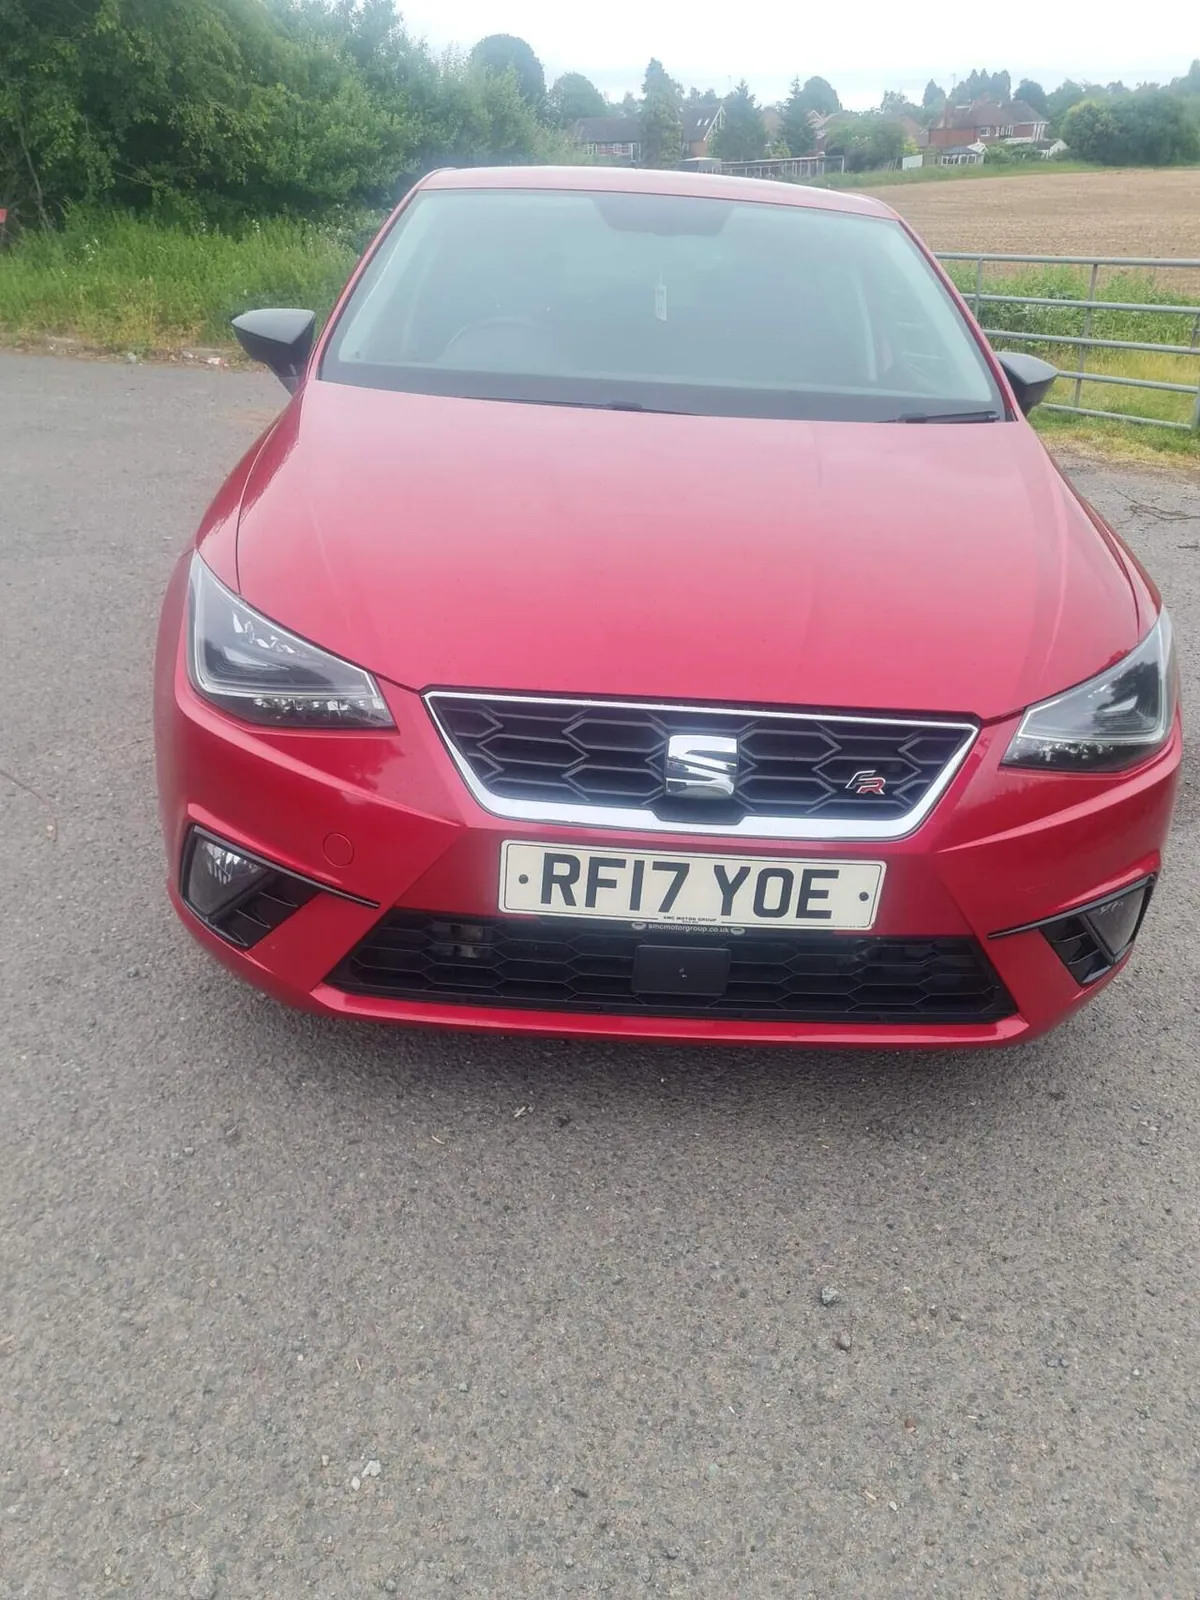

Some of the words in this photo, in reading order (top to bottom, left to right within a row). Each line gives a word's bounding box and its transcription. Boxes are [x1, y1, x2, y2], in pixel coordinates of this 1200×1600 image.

[845, 769, 886, 795] FR
[540, 852, 690, 912] RF17
[713, 864, 840, 920] YOE
[648, 923, 730, 934] smcmotorgroup.co.uk
